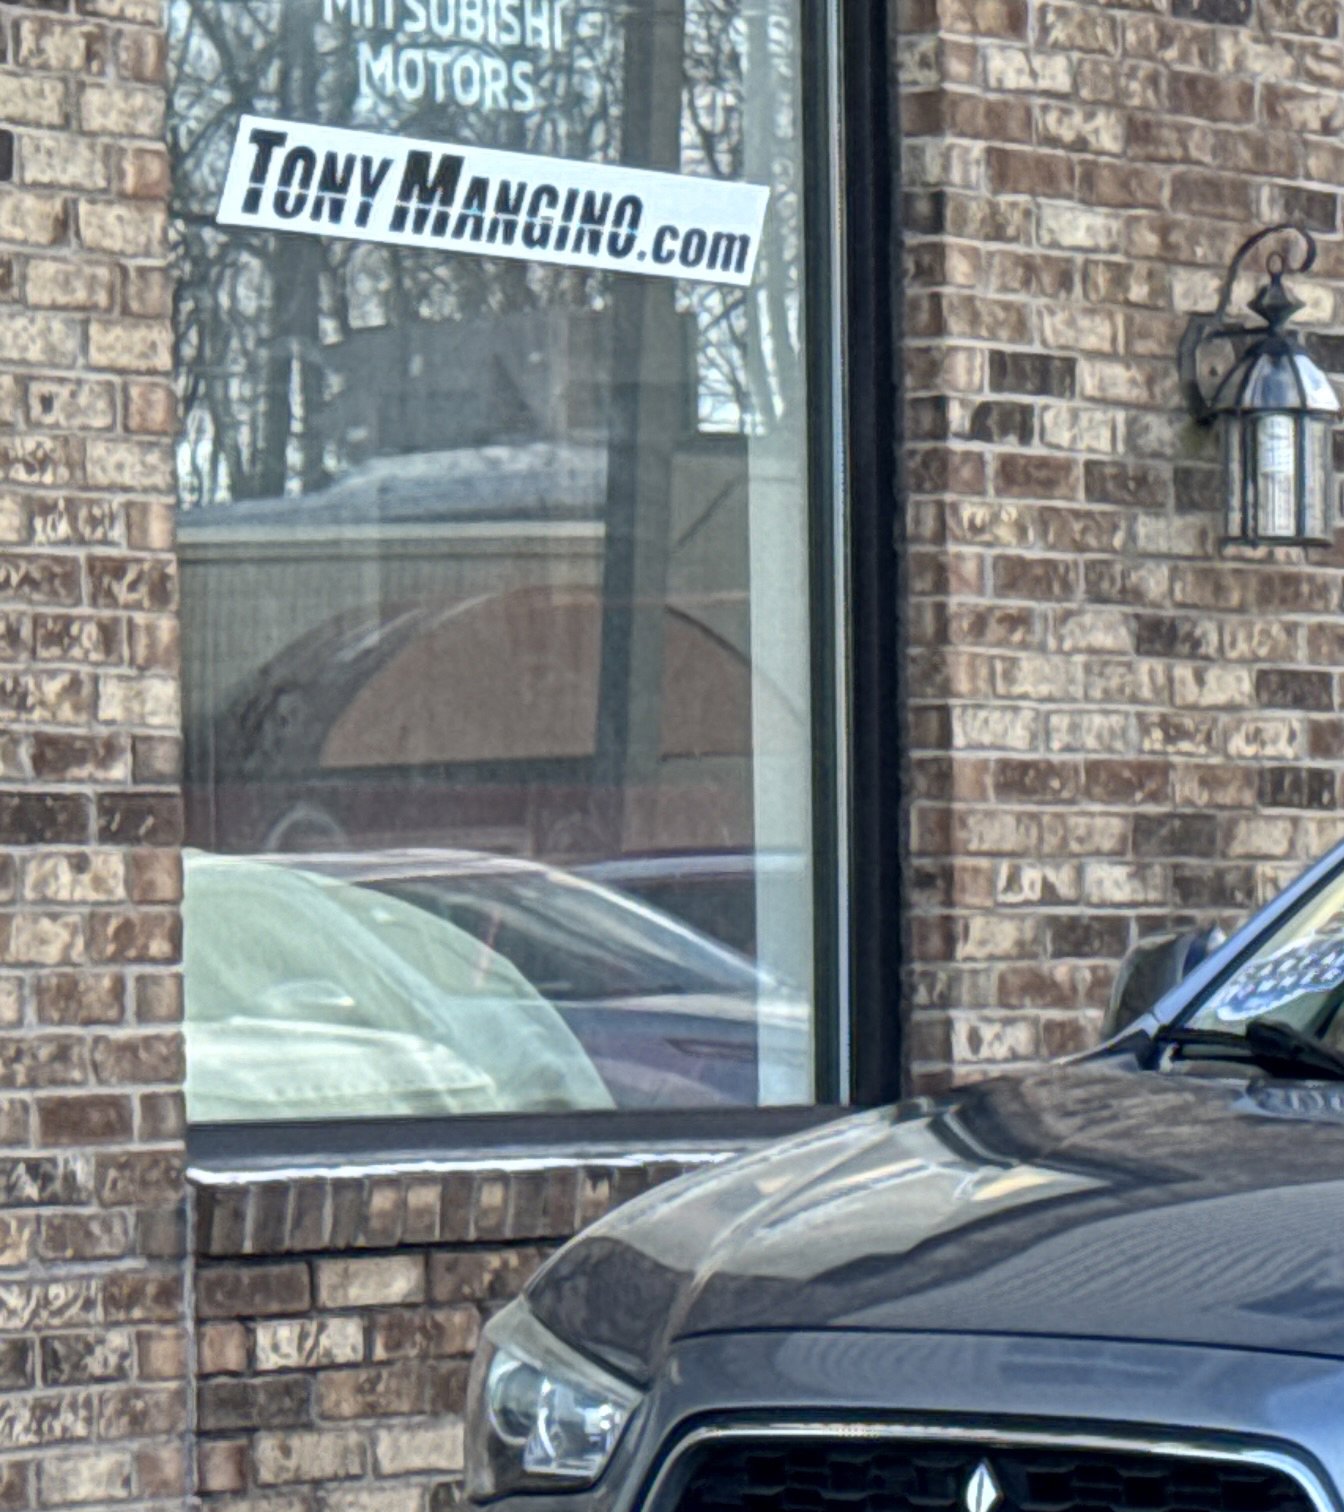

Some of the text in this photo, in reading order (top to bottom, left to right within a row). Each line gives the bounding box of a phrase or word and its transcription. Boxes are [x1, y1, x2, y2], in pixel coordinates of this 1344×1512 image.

[358, 41, 537, 112] MOTORS
[241, 129, 751, 274] TONY MANGINO.com
